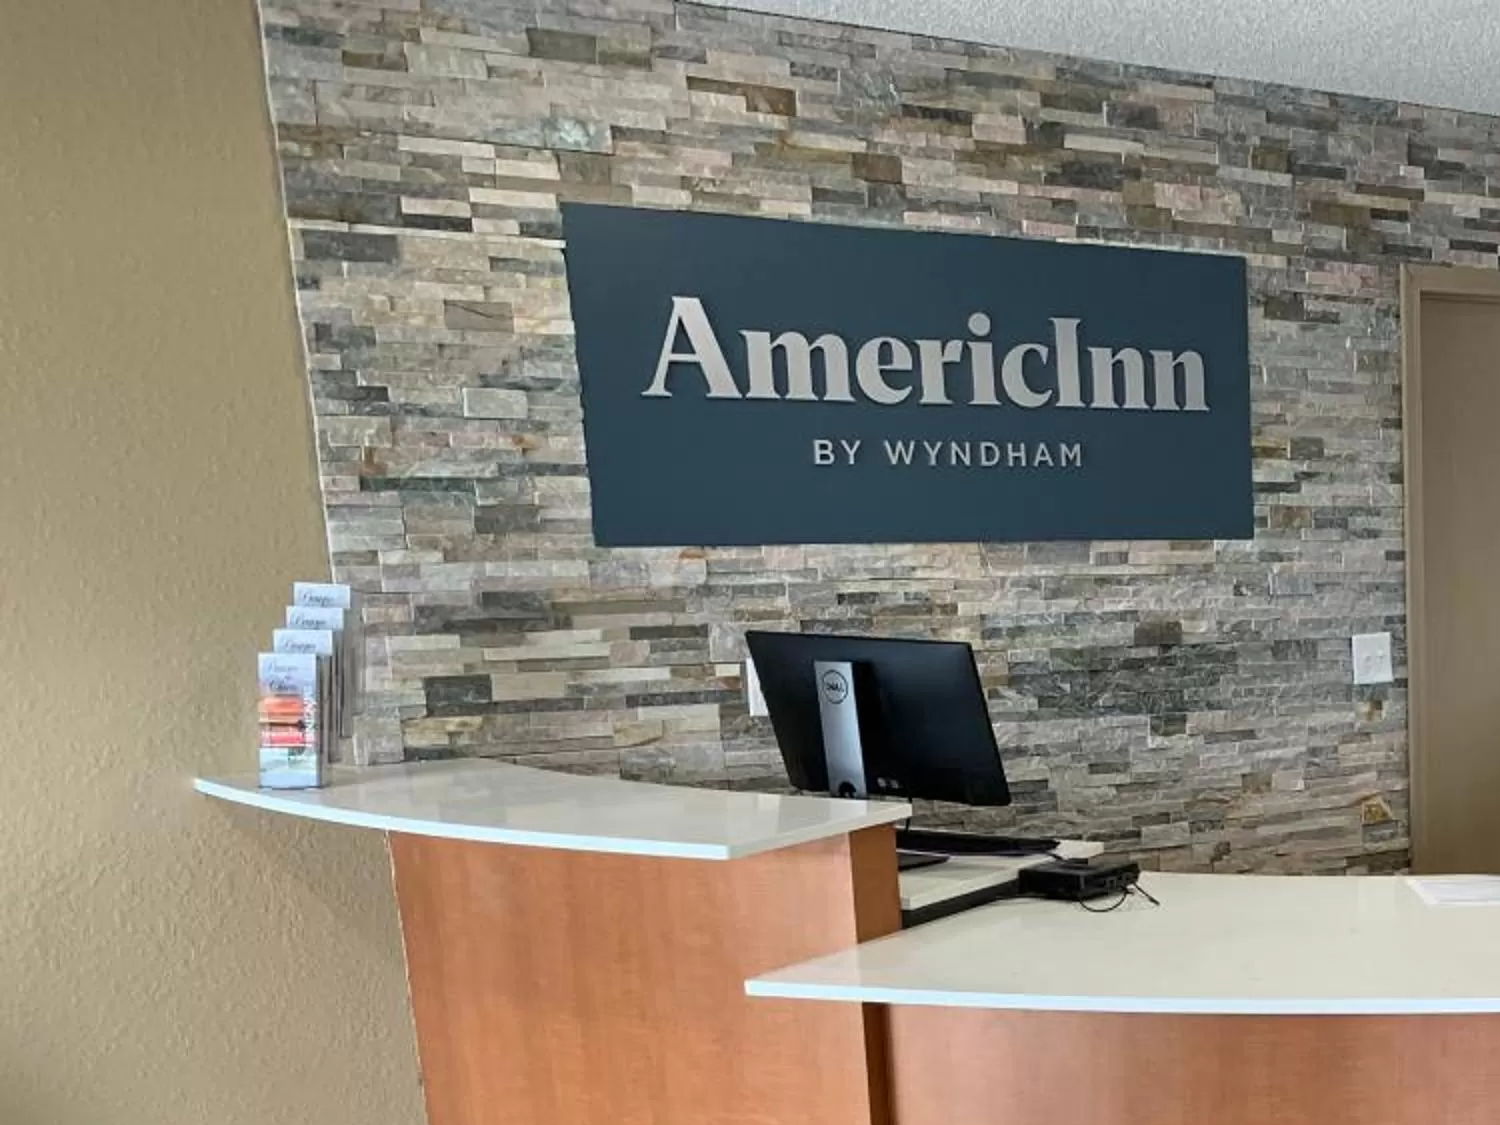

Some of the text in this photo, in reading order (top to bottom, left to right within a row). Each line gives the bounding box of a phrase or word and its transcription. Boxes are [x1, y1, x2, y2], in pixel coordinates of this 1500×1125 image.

[640, 295, 1209, 412] AmericInn
[813, 439, 1082, 467] BY WYNDHAM
